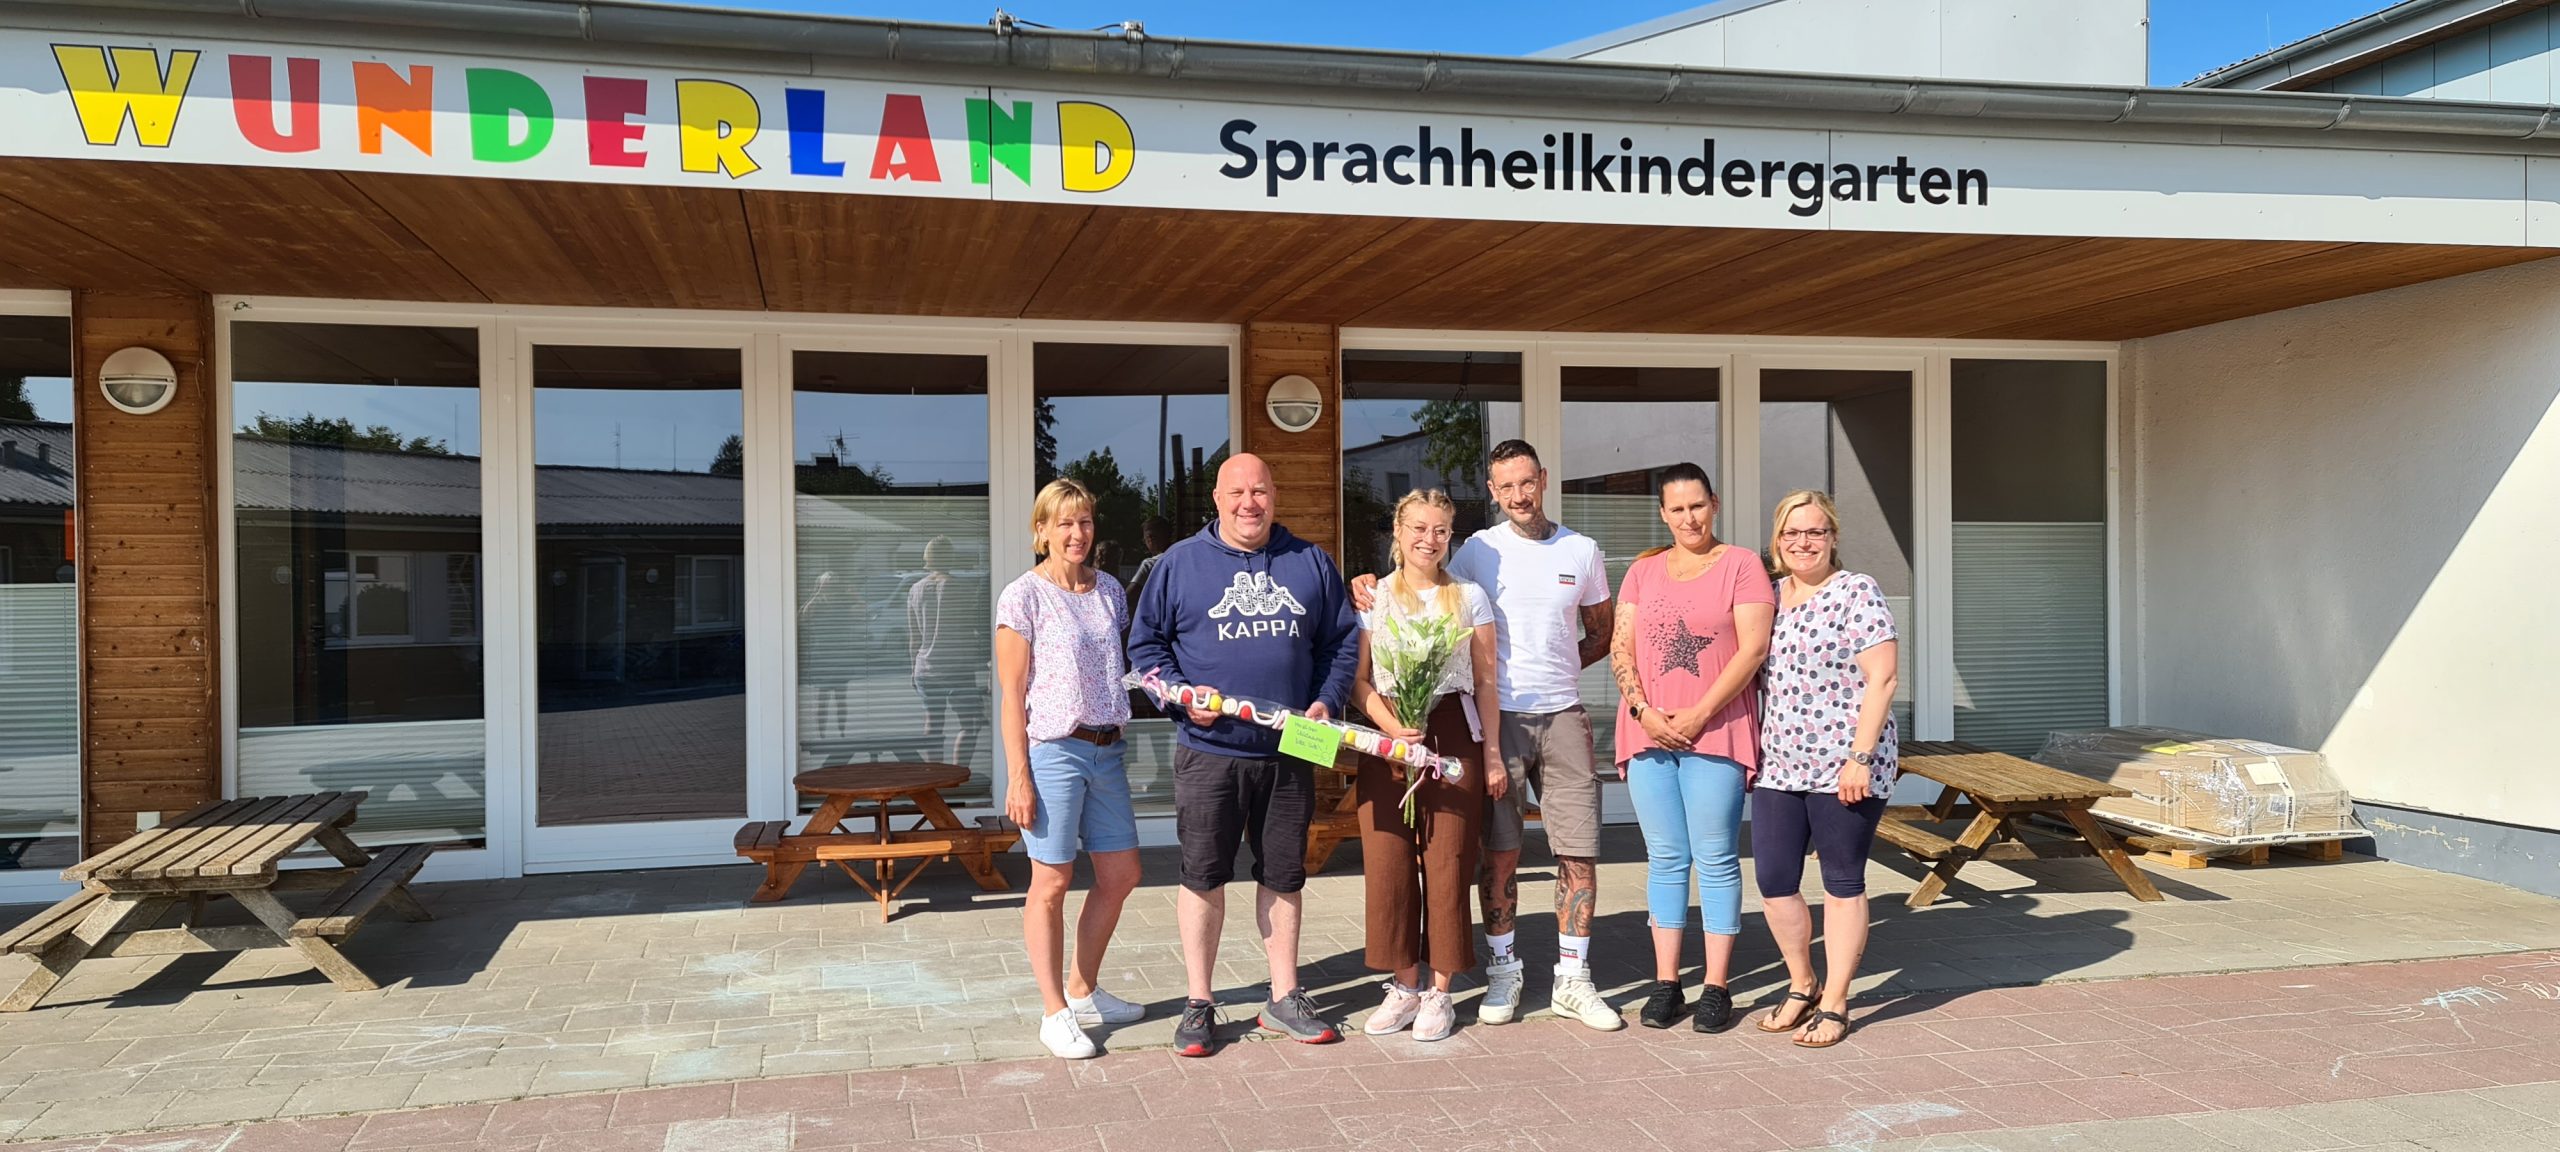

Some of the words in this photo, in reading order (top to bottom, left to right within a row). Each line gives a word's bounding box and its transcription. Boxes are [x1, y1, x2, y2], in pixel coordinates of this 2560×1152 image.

[50, 43, 1136, 193] WUNDERLAND
[1219, 119, 1989, 217] Sprachheilkindergarten
[1218, 619, 1300, 641] KAPPA
